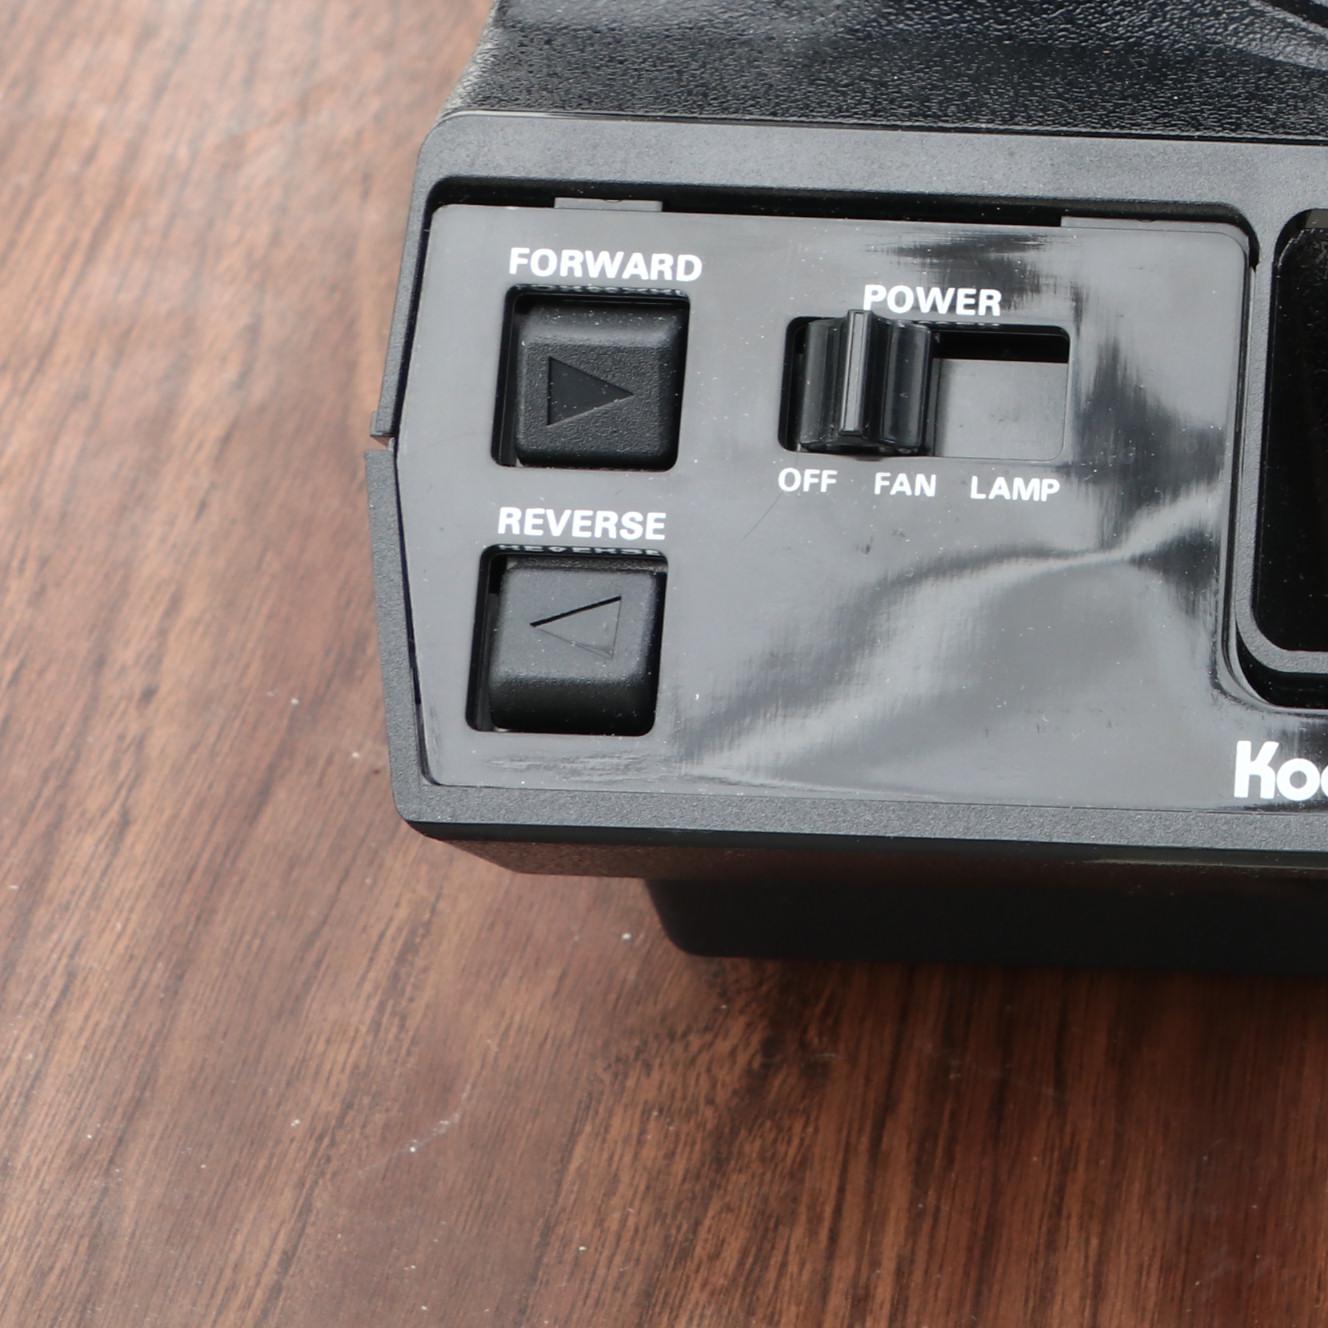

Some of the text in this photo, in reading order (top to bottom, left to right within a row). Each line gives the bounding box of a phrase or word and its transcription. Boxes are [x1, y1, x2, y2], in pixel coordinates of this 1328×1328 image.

[507, 246, 704, 283] FORWARD
[862, 283, 1003, 317] POWER
[777, 467, 1061, 503] OFF FAN LAMP
[497, 506, 668, 542] REVERSE
